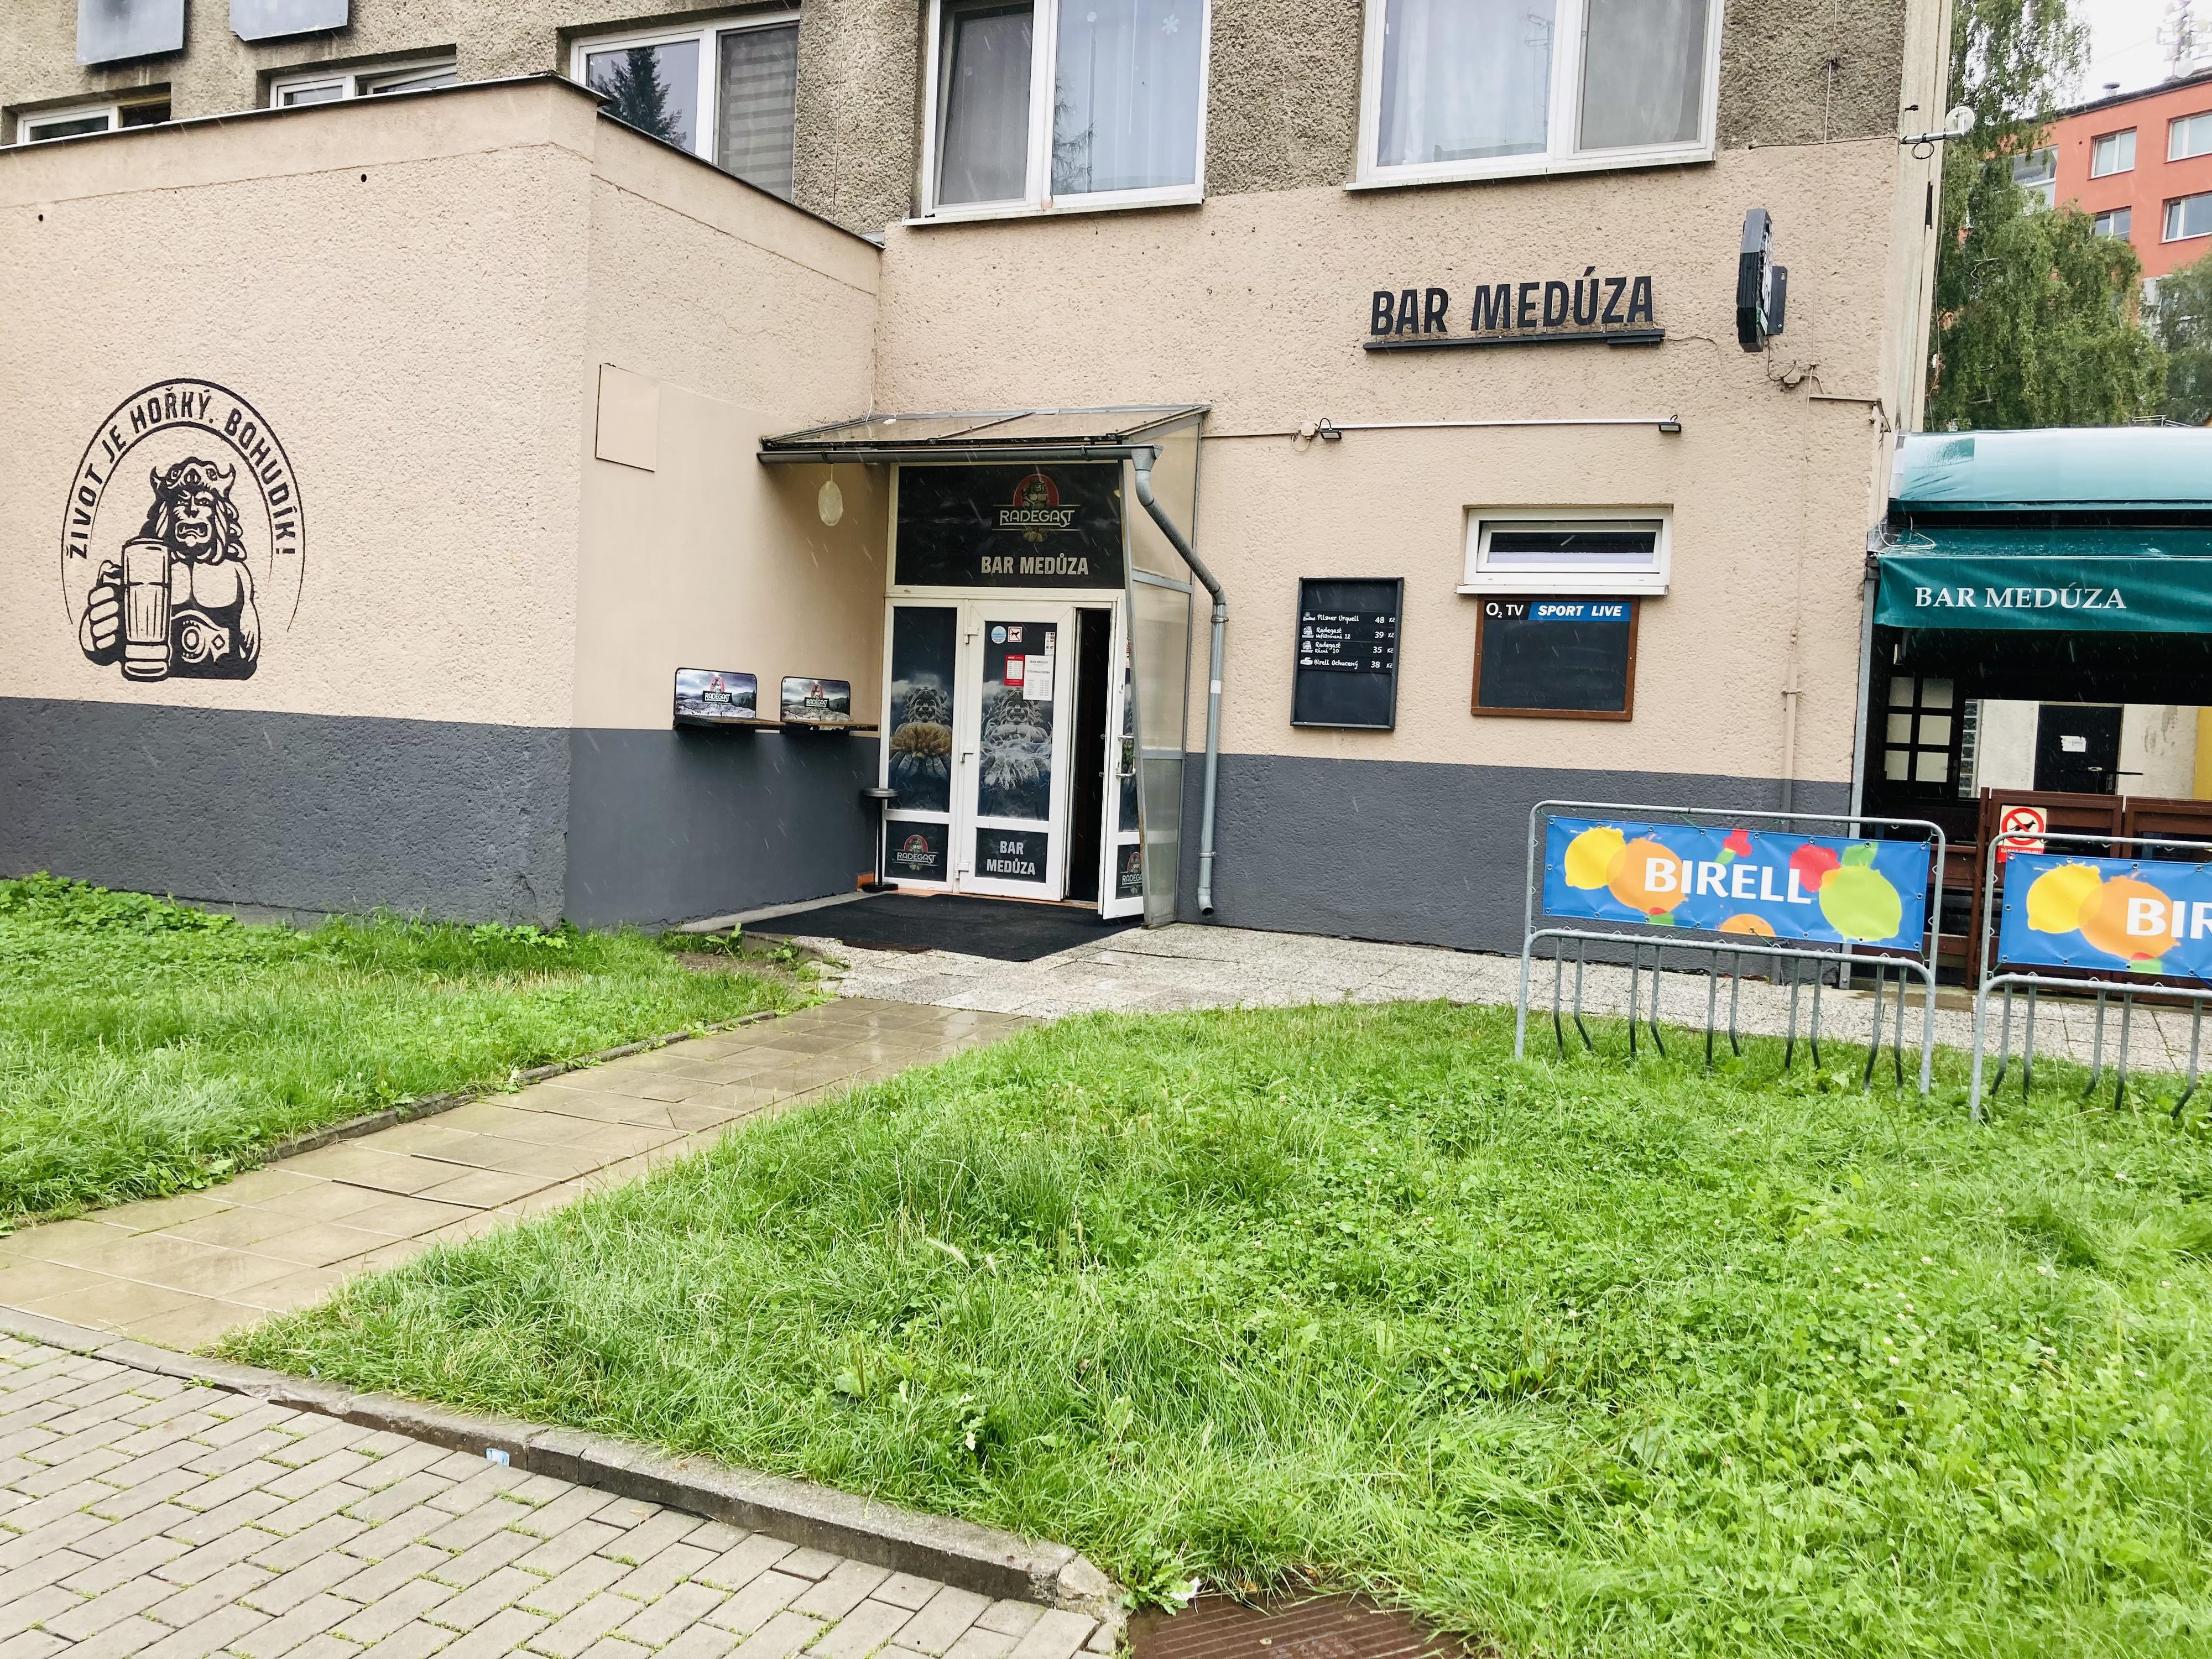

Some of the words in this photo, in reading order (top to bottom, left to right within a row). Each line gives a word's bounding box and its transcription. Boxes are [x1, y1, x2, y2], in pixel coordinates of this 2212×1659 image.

[1371, 288, 1448, 335] BAR
[1471, 266, 1653, 332] MEDÚZA
[66, 463, 102, 559] ŽIVOT
[102, 425, 127, 463] JE
[130, 386, 213, 434] HOŘKÝ.
[224, 408, 298, 555] BOHUDÍK!
[1000, 509, 1076, 528] RADEGAST
[981, 556, 1014, 574] BAR
[1020, 552, 1089, 575] MEDŮZA
[1914, 587, 1976, 607] BAR
[1984, 582, 2127, 609] MEDÚZA
[1506, 604, 1524, 615] TV
[1537, 605, 1584, 617] SPORT
[1591, 605, 1623, 617] LIVE
[1338, 615, 1359, 624] Urquell
[1316, 626, 1342, 635] Radegast
[1315, 641, 1341, 650] Radegast
[705, 692, 731, 703] RADEGAST
[806, 698, 828, 708] RADEGAST
[1000, 841, 1024, 855] BAR
[896, 852, 936, 864] RADEGAST
[987, 858, 1036, 875] MEDŮZA
[1122, 874, 1142, 885] RADEG
[1644, 857, 1812, 905] BIRELL
[2126, 897, 2212, 940] BIR
